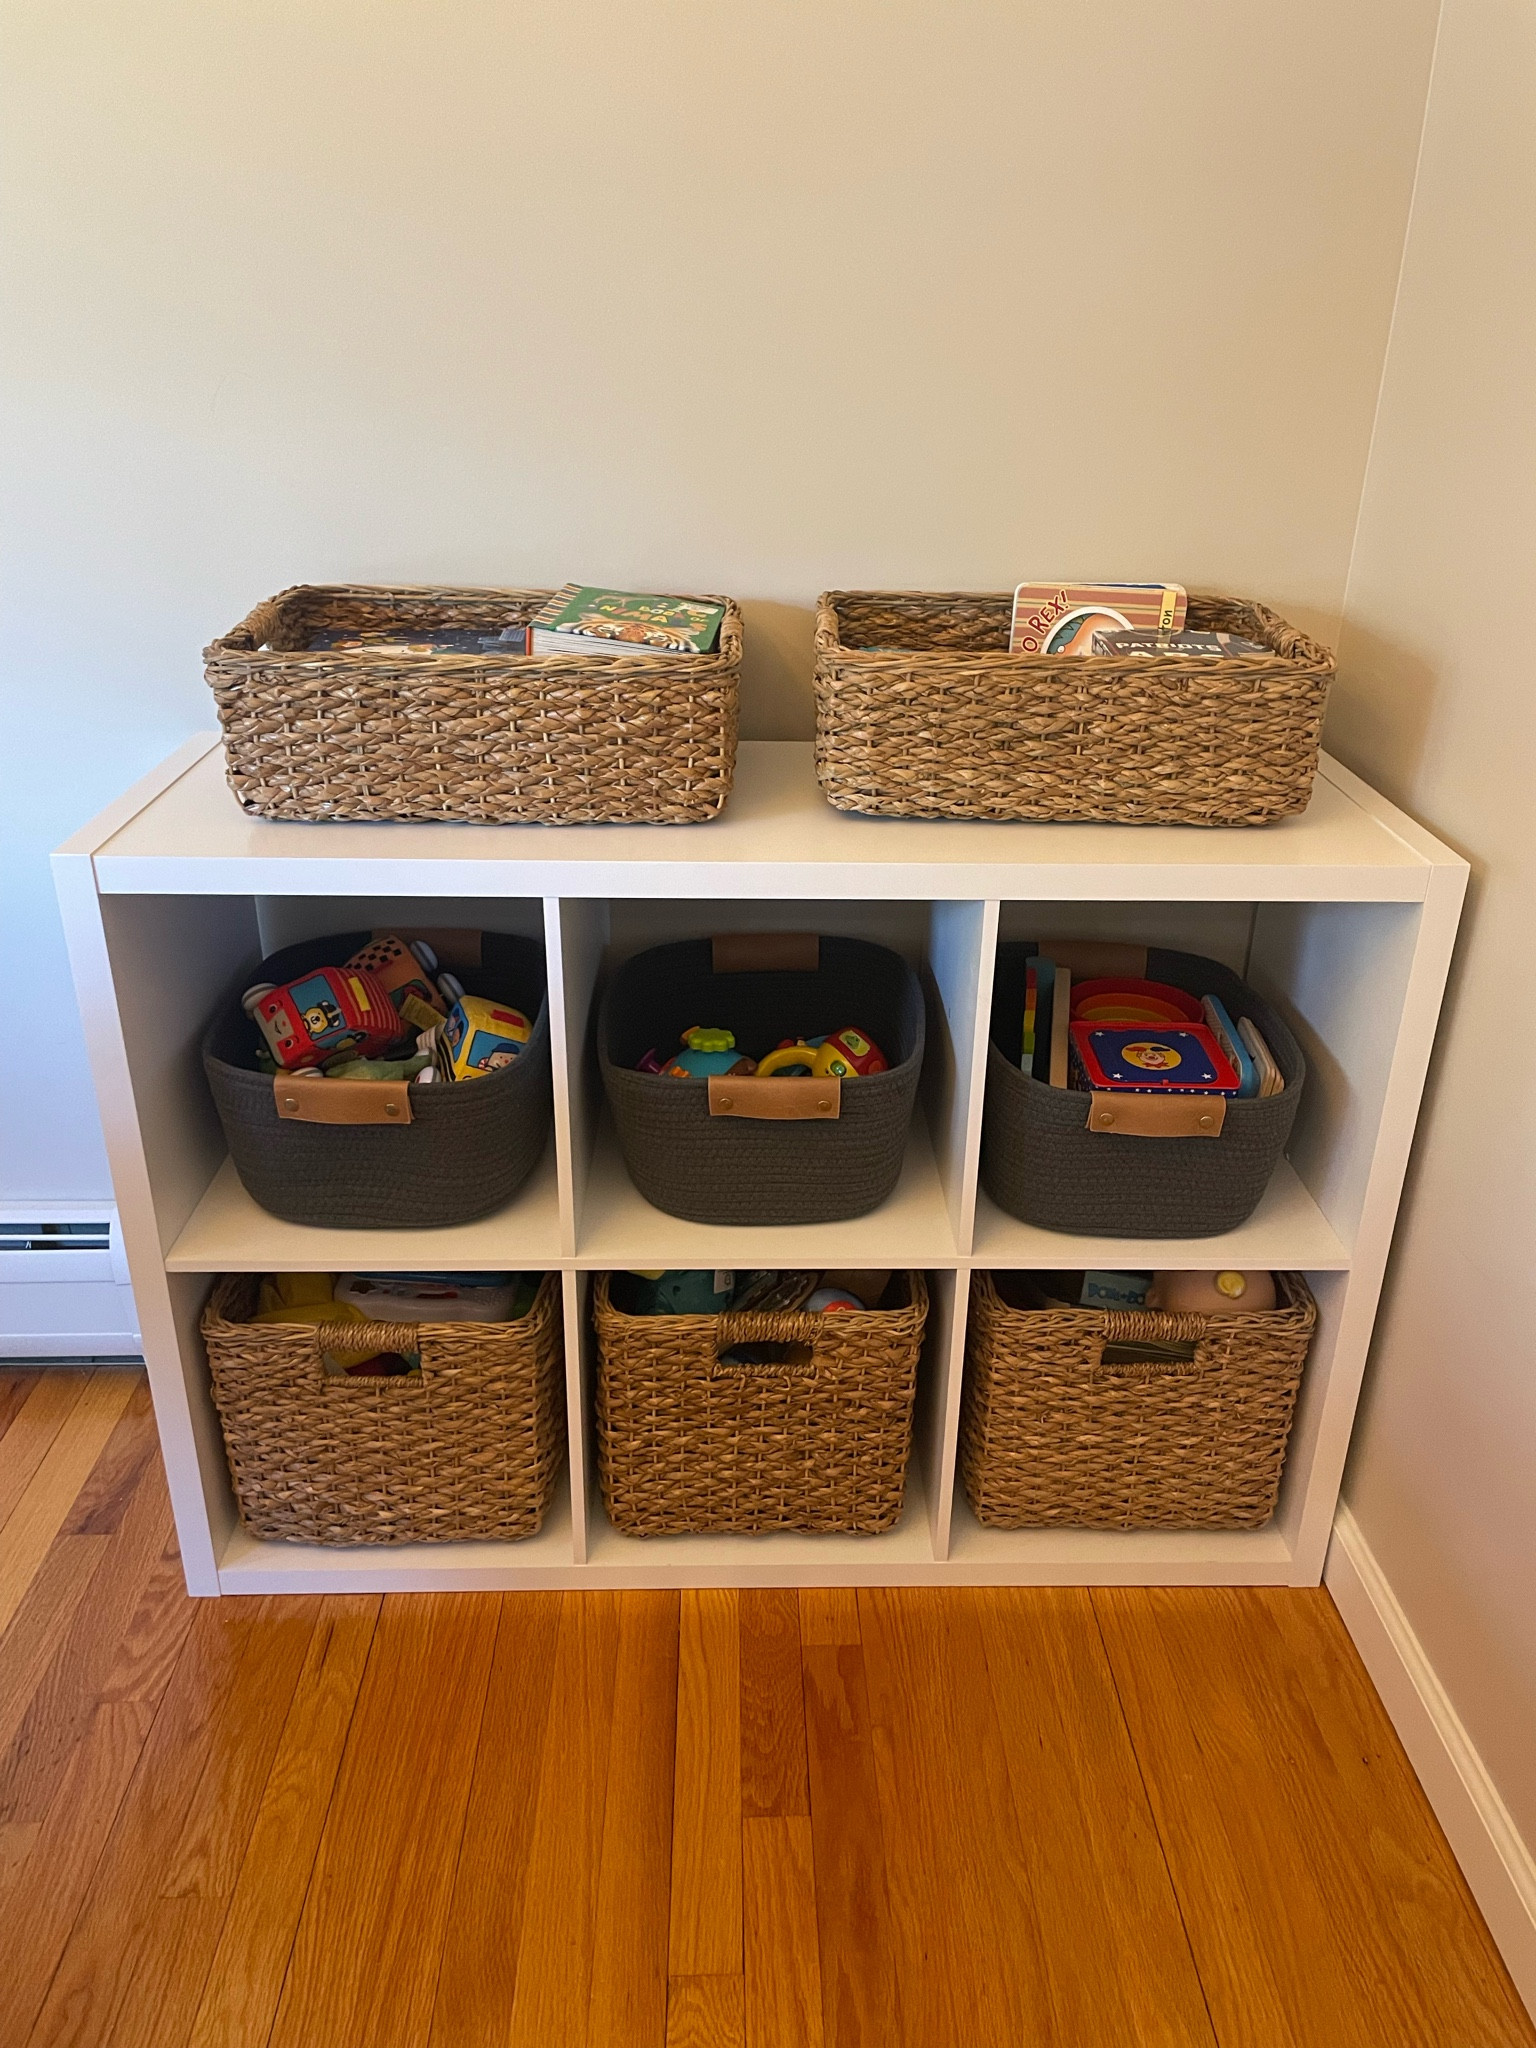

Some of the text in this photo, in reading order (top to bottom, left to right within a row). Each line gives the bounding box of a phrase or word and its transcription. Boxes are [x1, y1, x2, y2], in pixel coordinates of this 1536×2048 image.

[1028, 589, 1069, 634] REX!
[1158, 609, 1173, 631] ton
[1115, 642, 1222, 652] PATRIOTS
